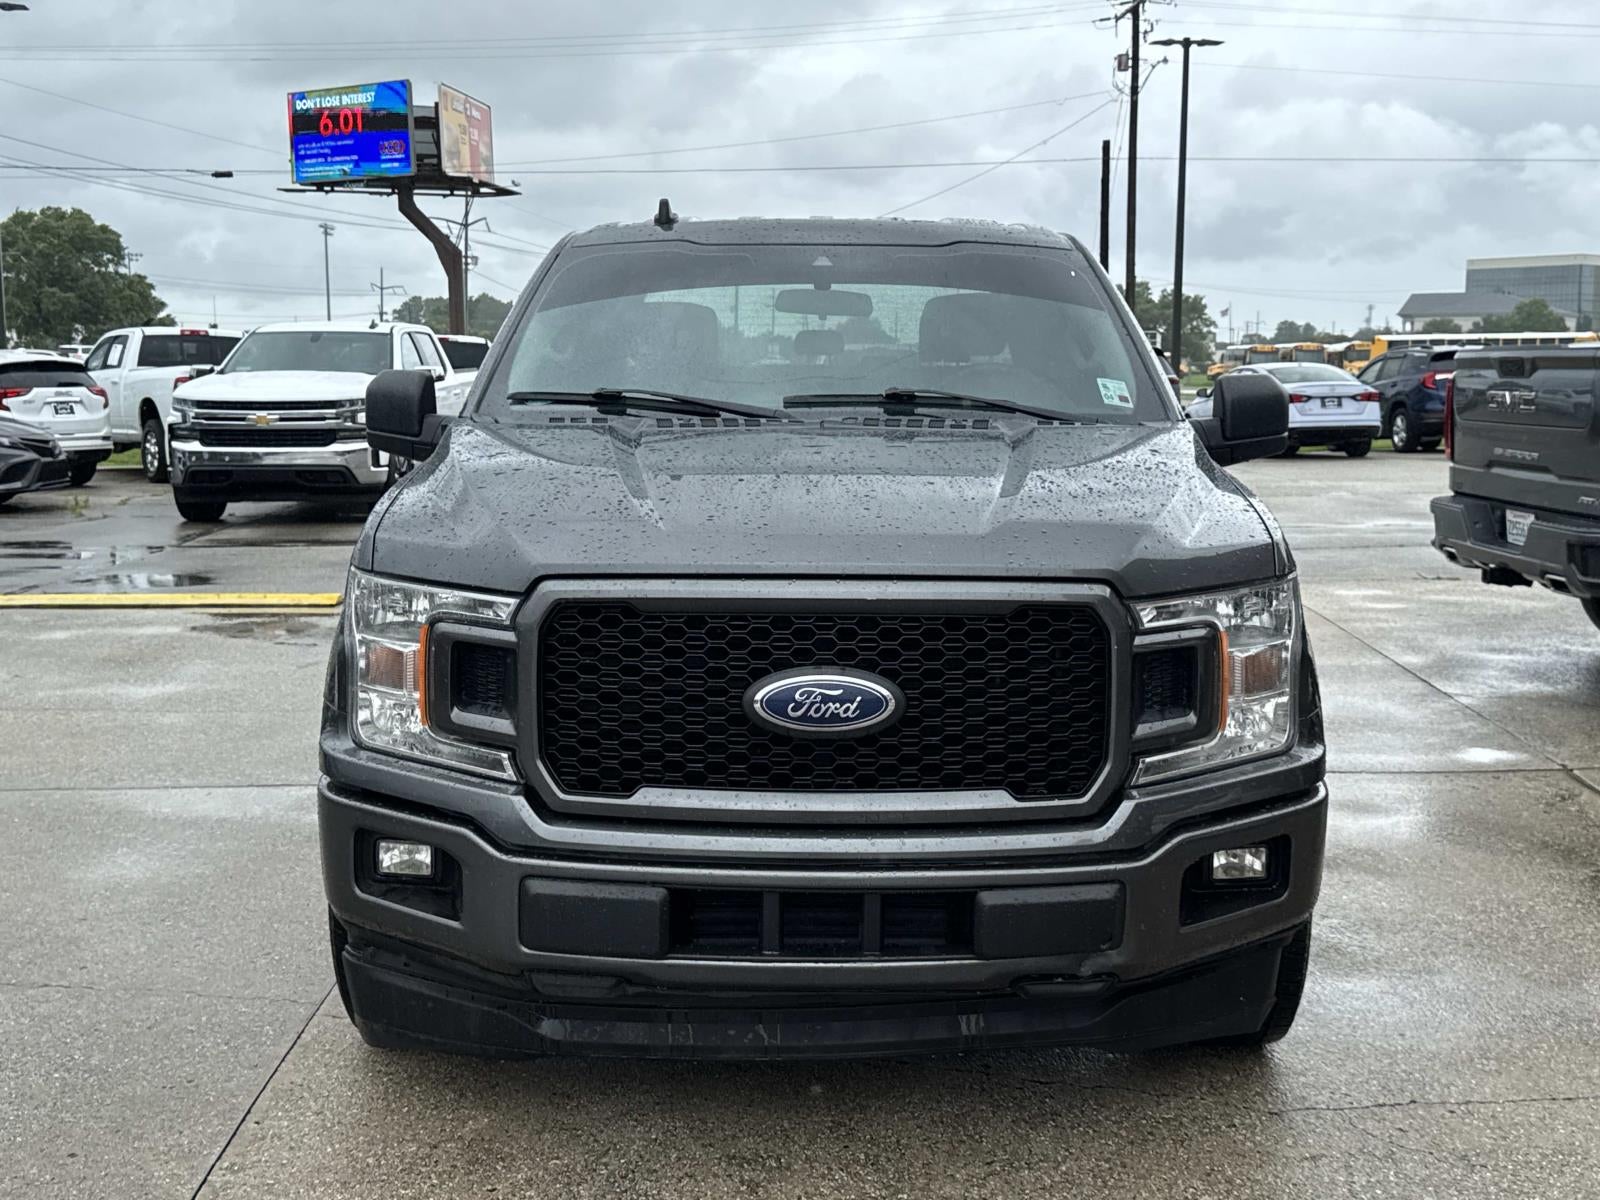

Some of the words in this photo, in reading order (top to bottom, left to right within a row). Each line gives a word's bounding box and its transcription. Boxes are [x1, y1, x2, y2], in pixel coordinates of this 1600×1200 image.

[295, 97, 320, 111] DON'T
[321, 95, 340, 107] LOSE
[341, 91, 375, 105] INTEREST
[320, 107, 363, 137] 6.01
[1487, 390, 1536, 412] GMC
[787, 687, 862, 718] Ford
